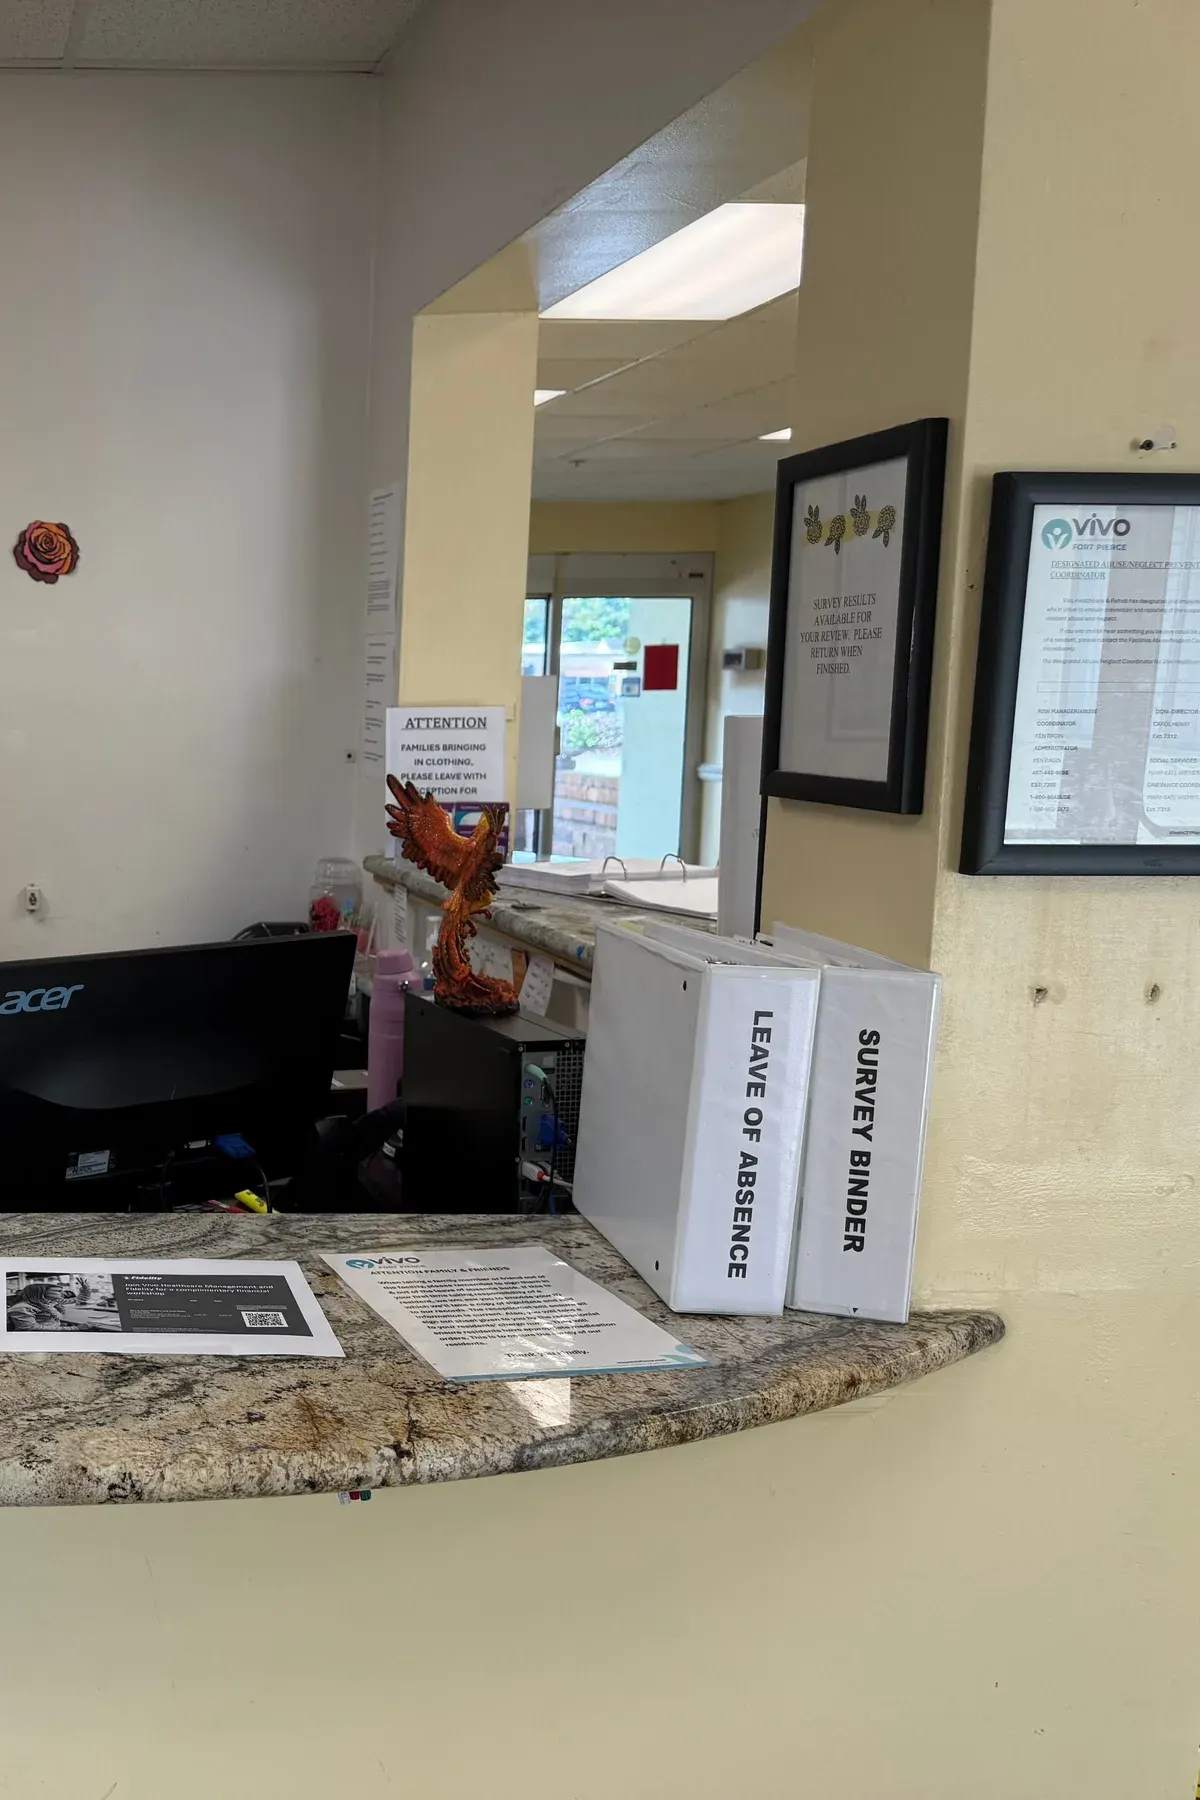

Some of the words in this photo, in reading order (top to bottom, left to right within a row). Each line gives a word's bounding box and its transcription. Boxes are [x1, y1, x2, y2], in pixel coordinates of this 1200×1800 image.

[1096, 543, 1127, 551] PIERCE
[1051, 560, 1099, 569] DESIGNATED
[1050, 571, 1106, 580] COORDINATOR
[813, 597, 843, 610] SURVEY
[843, 593, 876, 607] RESULTS
[813, 612, 856, 626] AVAILABLE
[856, 611, 872, 623] FOR
[800, 631, 820, 643] YOUR
[820, 629, 851, 642] REVIEW.
[853, 627, 882, 640] PLEASE
[810, 647, 839, 658] RETURN
[840, 645, 863, 657] WHEN
[816, 663, 851, 674] FINISHED.
[403, 717, 487, 730] ATTENTION
[401, 743, 441, 752] FAMILIES
[442, 743, 486, 752] BRINGING
[414, 758, 424, 766] IN
[425, 758, 475, 767] CLOTHING,
[400, 773, 433, 781] PLEASE
[435, 772, 462, 781] LEAVE
[463, 772, 487, 780] WITH
[419, 787, 458, 795] CEPTION
[460, 786, 478, 795] FOR
[743, 1010, 773, 1098] LEAVE
[851, 1029, 881, 1143] SURVEY
[742, 1107, 763, 1143] OF
[843, 1150, 872, 1254] BINDER
[727, 1150, 759, 1279] ABSENCE
